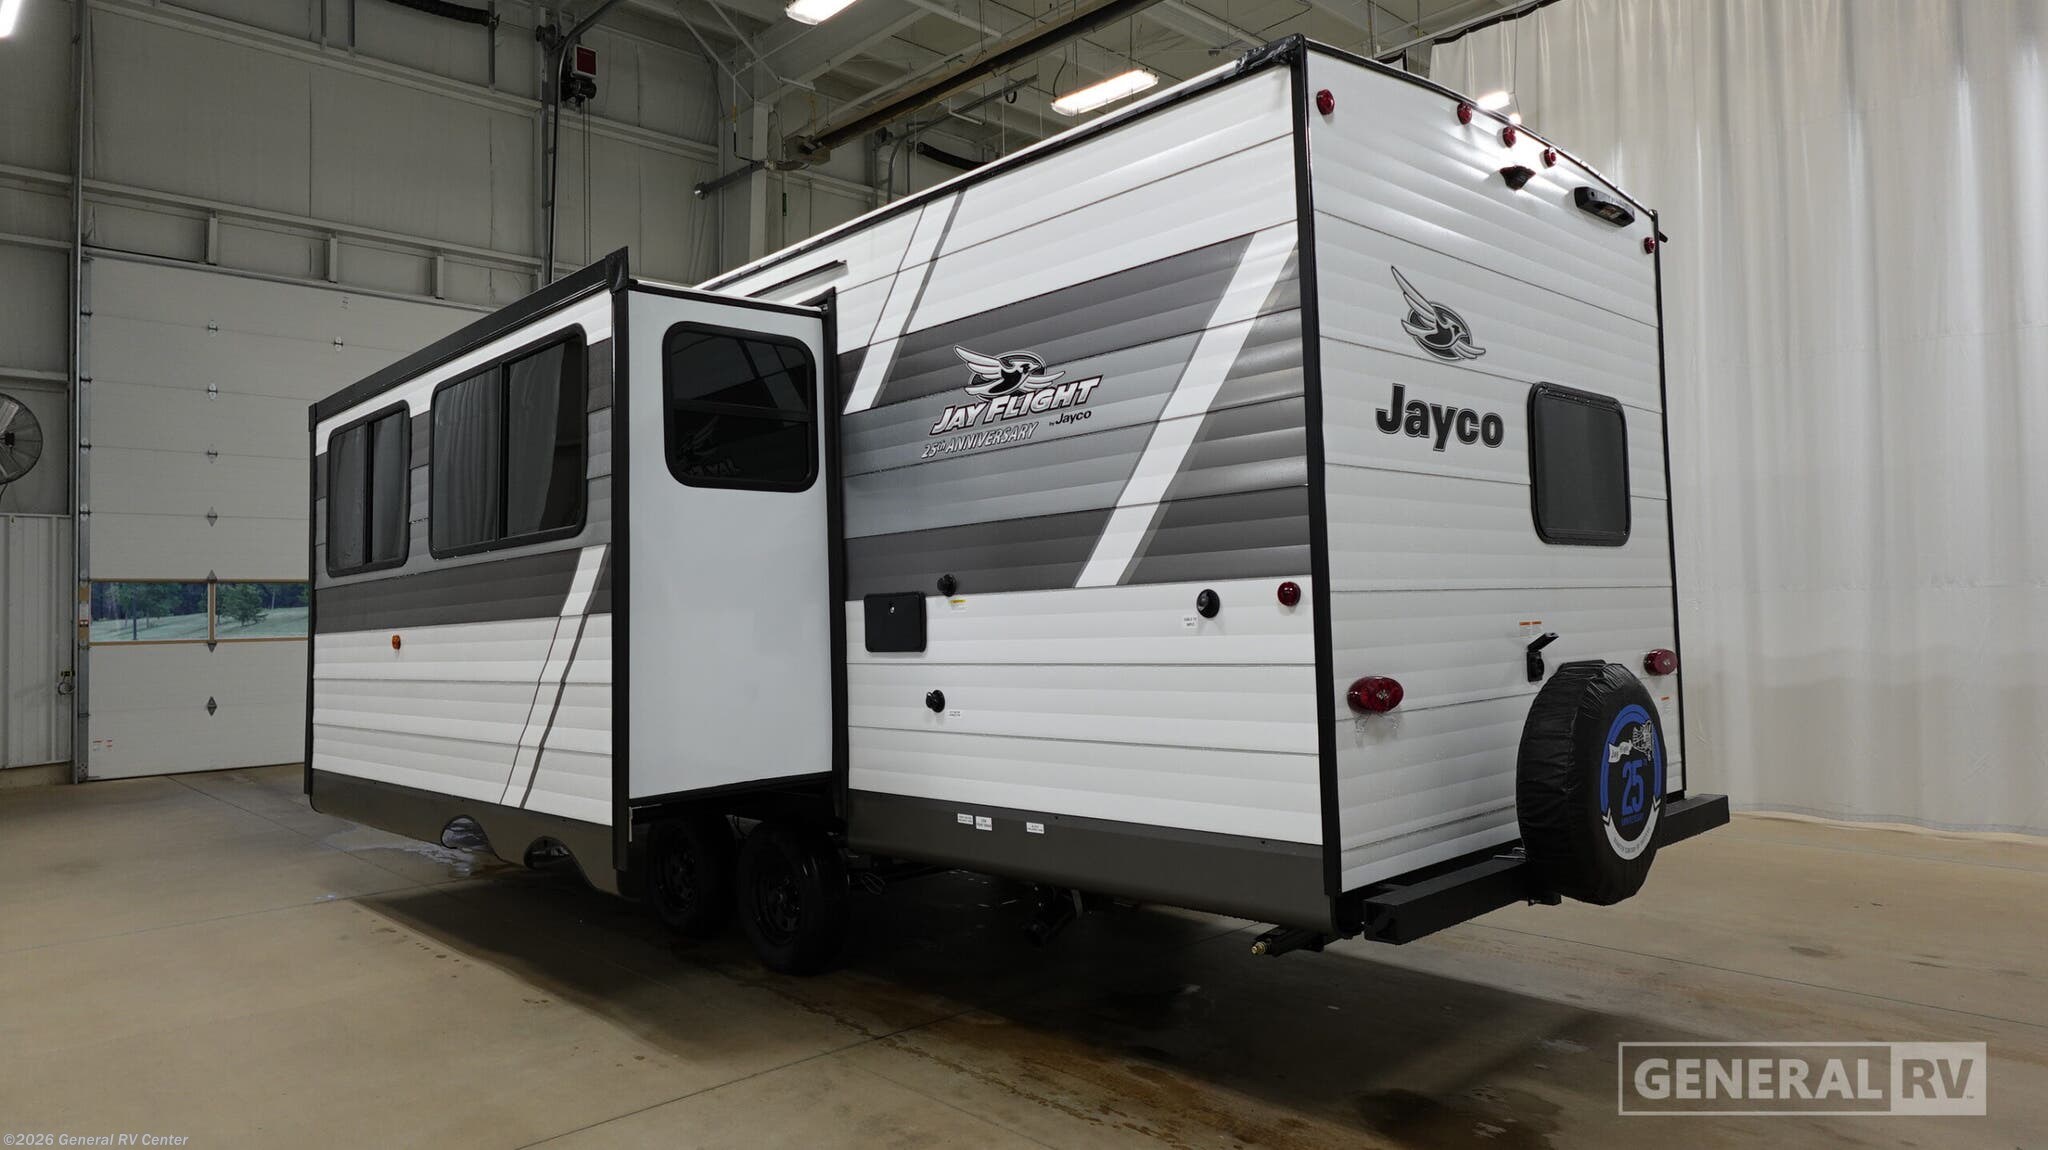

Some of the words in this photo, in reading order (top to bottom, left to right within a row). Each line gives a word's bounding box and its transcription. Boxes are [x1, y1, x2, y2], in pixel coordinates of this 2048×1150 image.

[929, 402, 986, 436] JAY
[982, 375, 1104, 425] FLIGHT
[1055, 410, 1092, 425] Jayco
[1375, 382, 1504, 452] Jayco
[945, 421, 1040, 453] ANNIVERSARY
